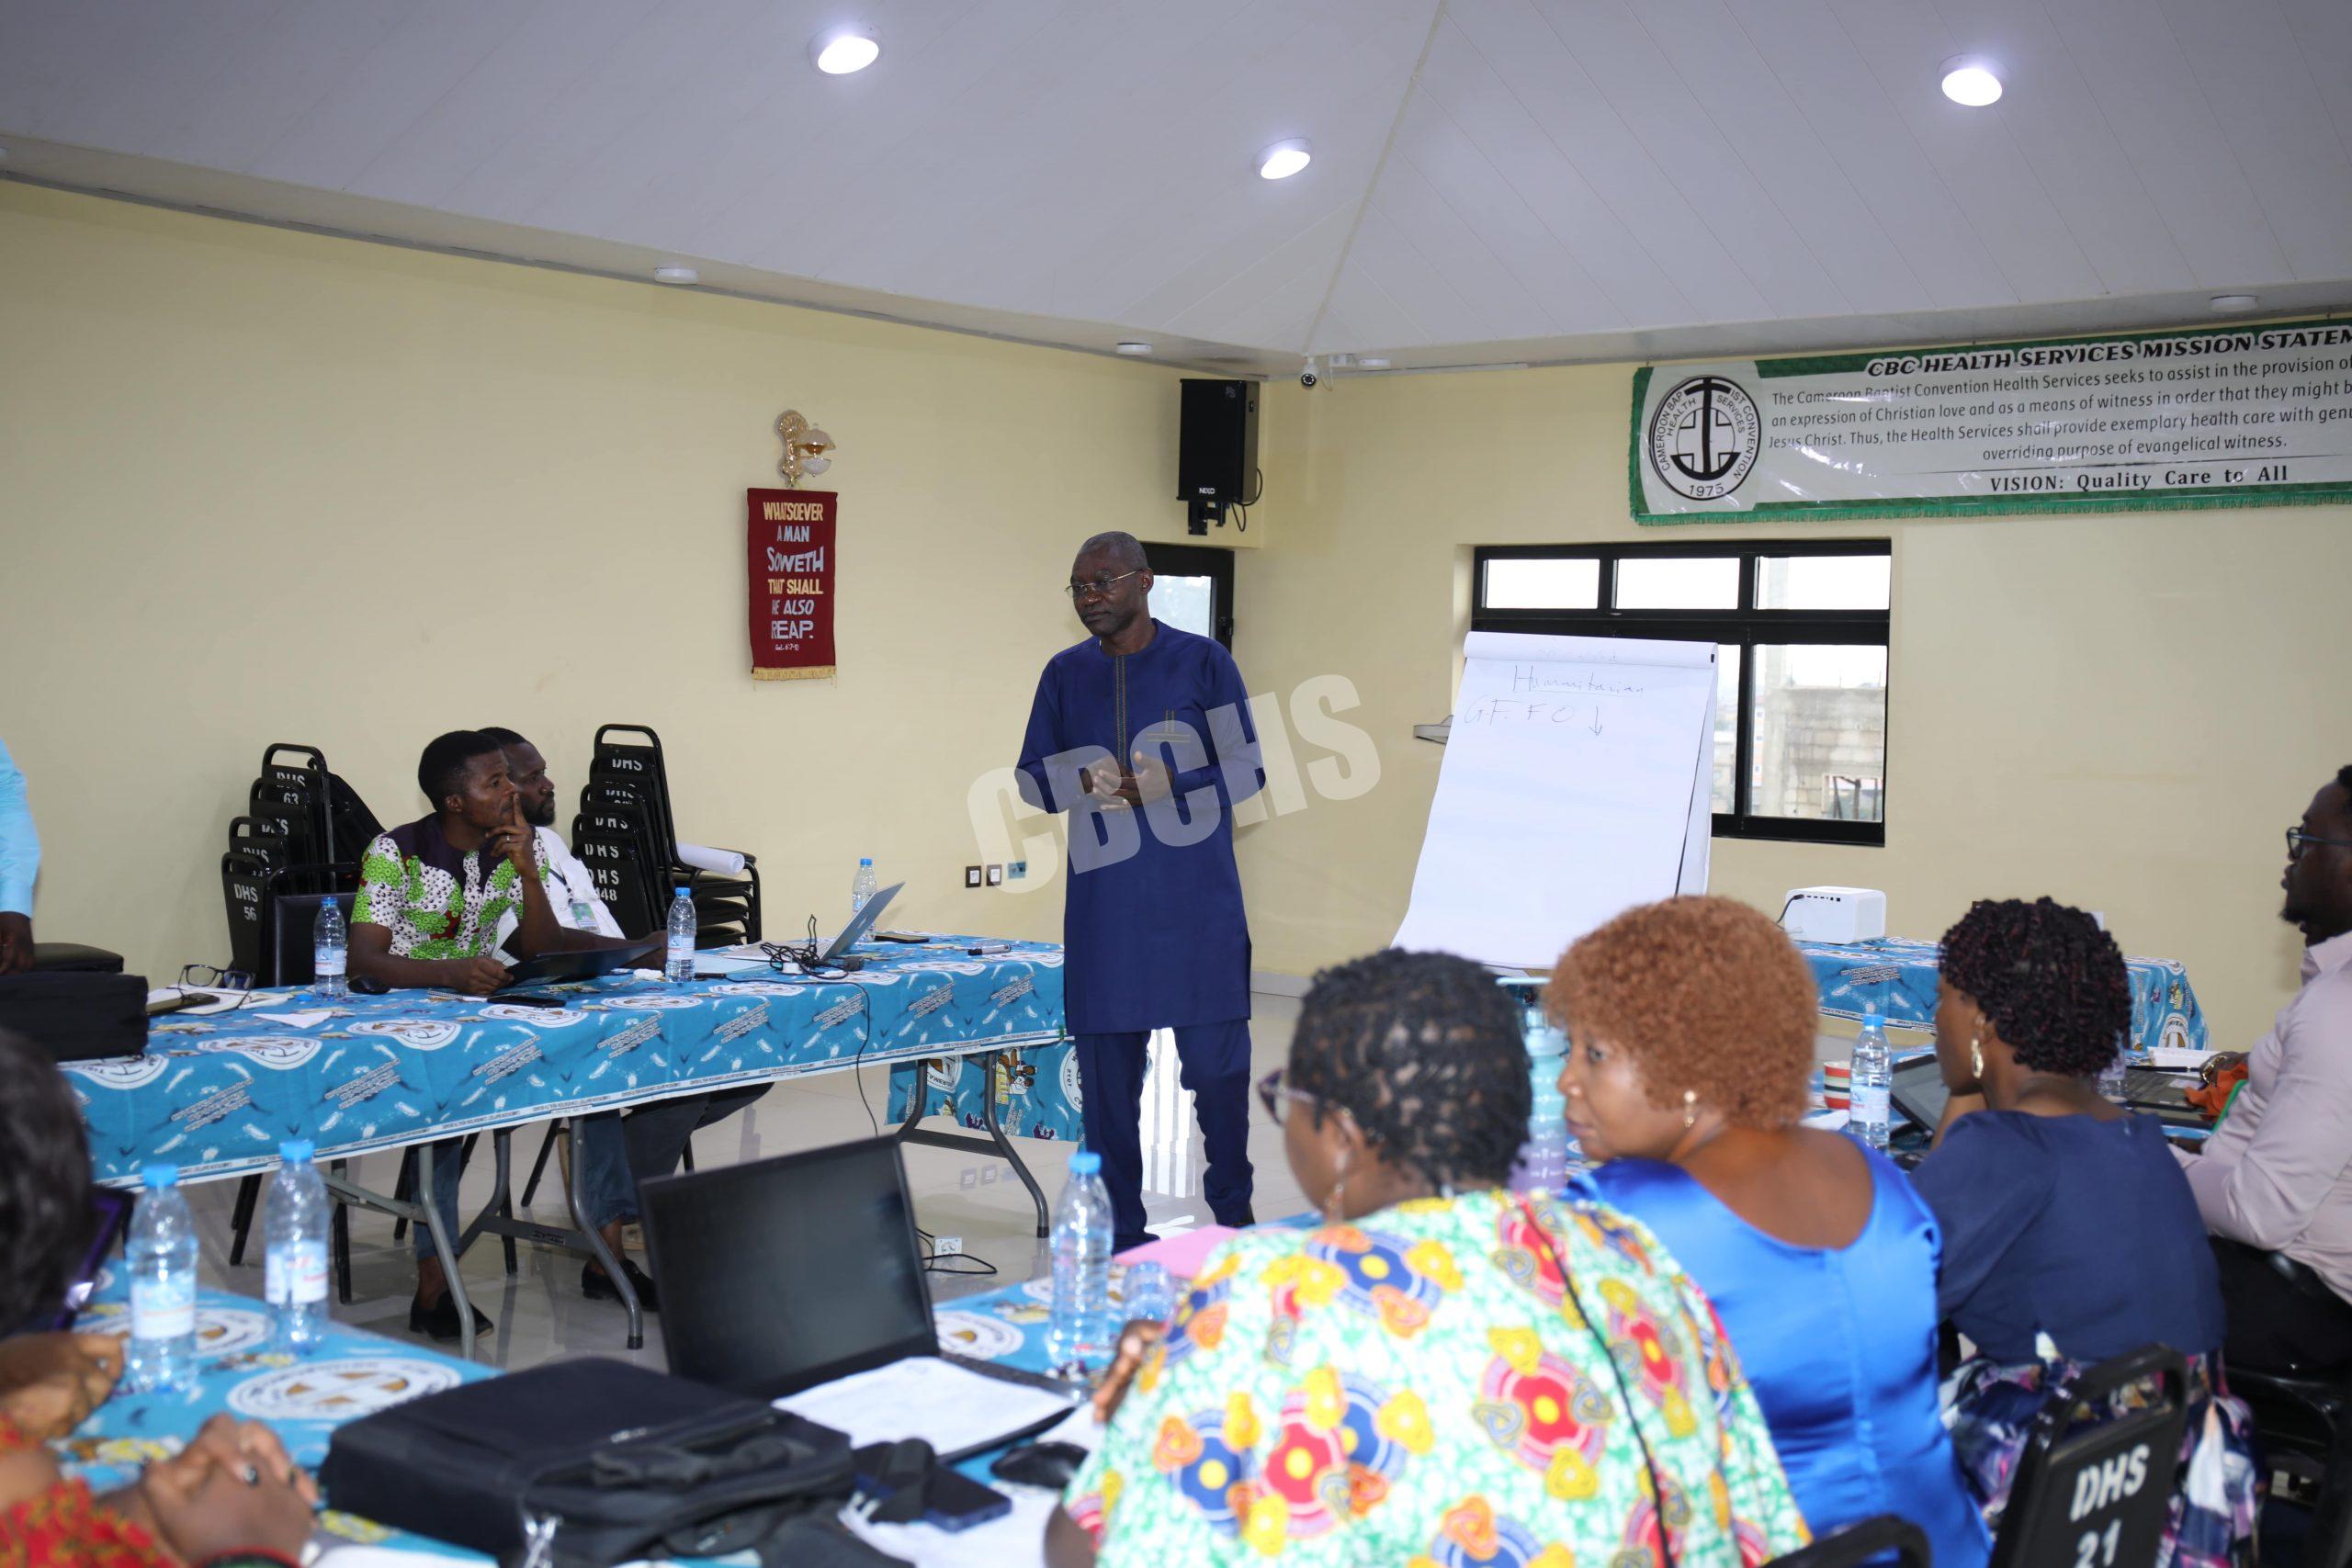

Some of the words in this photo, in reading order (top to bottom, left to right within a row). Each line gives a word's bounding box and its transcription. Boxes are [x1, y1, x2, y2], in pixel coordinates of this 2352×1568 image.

[1868, 359, 1917, 377] CBC
[1923, 353, 2012, 373] HEALTH
[2019, 344, 2133, 367] SERVICES
[2143, 336, 2251, 358] MISSION
[1772, 391, 1793, 405] The
[1797, 389, 1860, 404] Cameroon
[1914, 378, 1989, 397] Convention
[1994, 375, 2039, 392] Health
[2042, 372, 2100, 389] Services
[2105, 368, 2144, 385] seeks
[2146, 369, 2163, 382] to
[2167, 364, 2211, 381] assist
[2215, 362, 2228, 378] in
[2233, 361, 2257, 378] the
[2262, 356, 2334, 378] provision
[1667, 398, 1696, 436] HEALTH
[1716, 394, 1745, 434] SERVICES
[1771, 414, 1786, 427] an
[1791, 411, 1856, 429] expression
[1860, 409, 1872, 423] of
[1876, 406, 1935, 422] Christian
[1939, 404, 1965, 418] love
[1969, 400, 1995, 416] and
[1998, 402, 2013, 414] as
[2017, 401, 2025, 413] a
[2029, 399, 2075, 412] means
[2079, 393, 2094, 411] of
[2098, 393, 2153, 409] witness
[2157, 390, 2170, 405] in
[2175, 388, 2215, 404] order
[2219, 387, 2250, 402] that
[2255, 384, 2289, 401] they
[2292, 380, 2339, 400] might
[1804, 433, 1847, 446] Christ.
[1850, 430, 1883, 446] Thus,
[1886, 429, 1907, 443] the
[1911, 426, 1954, 441] Health
[1958, 423, 2013, 440] Services
[2017, 421, 2050, 437] shall
[2053, 417, 2106, 437] provide
[2110, 414, 2187, 433] exemplary
[2190, 410, 2238, 427] health
[2243, 411, 2275, 424] care
[2279, 406, 2313, 423] with
[1656, 411, 1671, 471] CAMEROON
[1734, 405, 1756, 480] CONVENTION
[1983, 444, 2052, 460] overriding
[2058, 445, 2114, 460] purpose
[2118, 438, 2133, 454] of
[2137, 434, 2220, 456] evangelical
[2224, 434, 2287, 449] witness.
[1198, 486, 1216, 495] NEXO
[1690, 482, 1724, 497] 1975
[1990, 474, 2064, 492] VISION:
[2077, 471, 2152, 492] Quality
[2165, 469, 2211, 486] Care
[2224, 468, 2245, 484] to
[2257, 465, 2288, 482] All
[763, 501, 824, 523] WHATSOEVER
[776, 525, 783, 543] A
[784, 525, 809, 543] MAN
[767, 578, 786, 595] THAT
[786, 578, 824, 595] SHALL
[772, 599, 779, 615] HE
[783, 599, 815, 615] ALSO
[771, 619, 814, 640] REAP.
[584, 843, 619, 859] DHS
[233, 883, 259, 903] DHS
[243, 906, 257, 921] 56
[2070, 1443, 2151, 1522] DHS
[2074, 1518, 2122, 1568] 21
